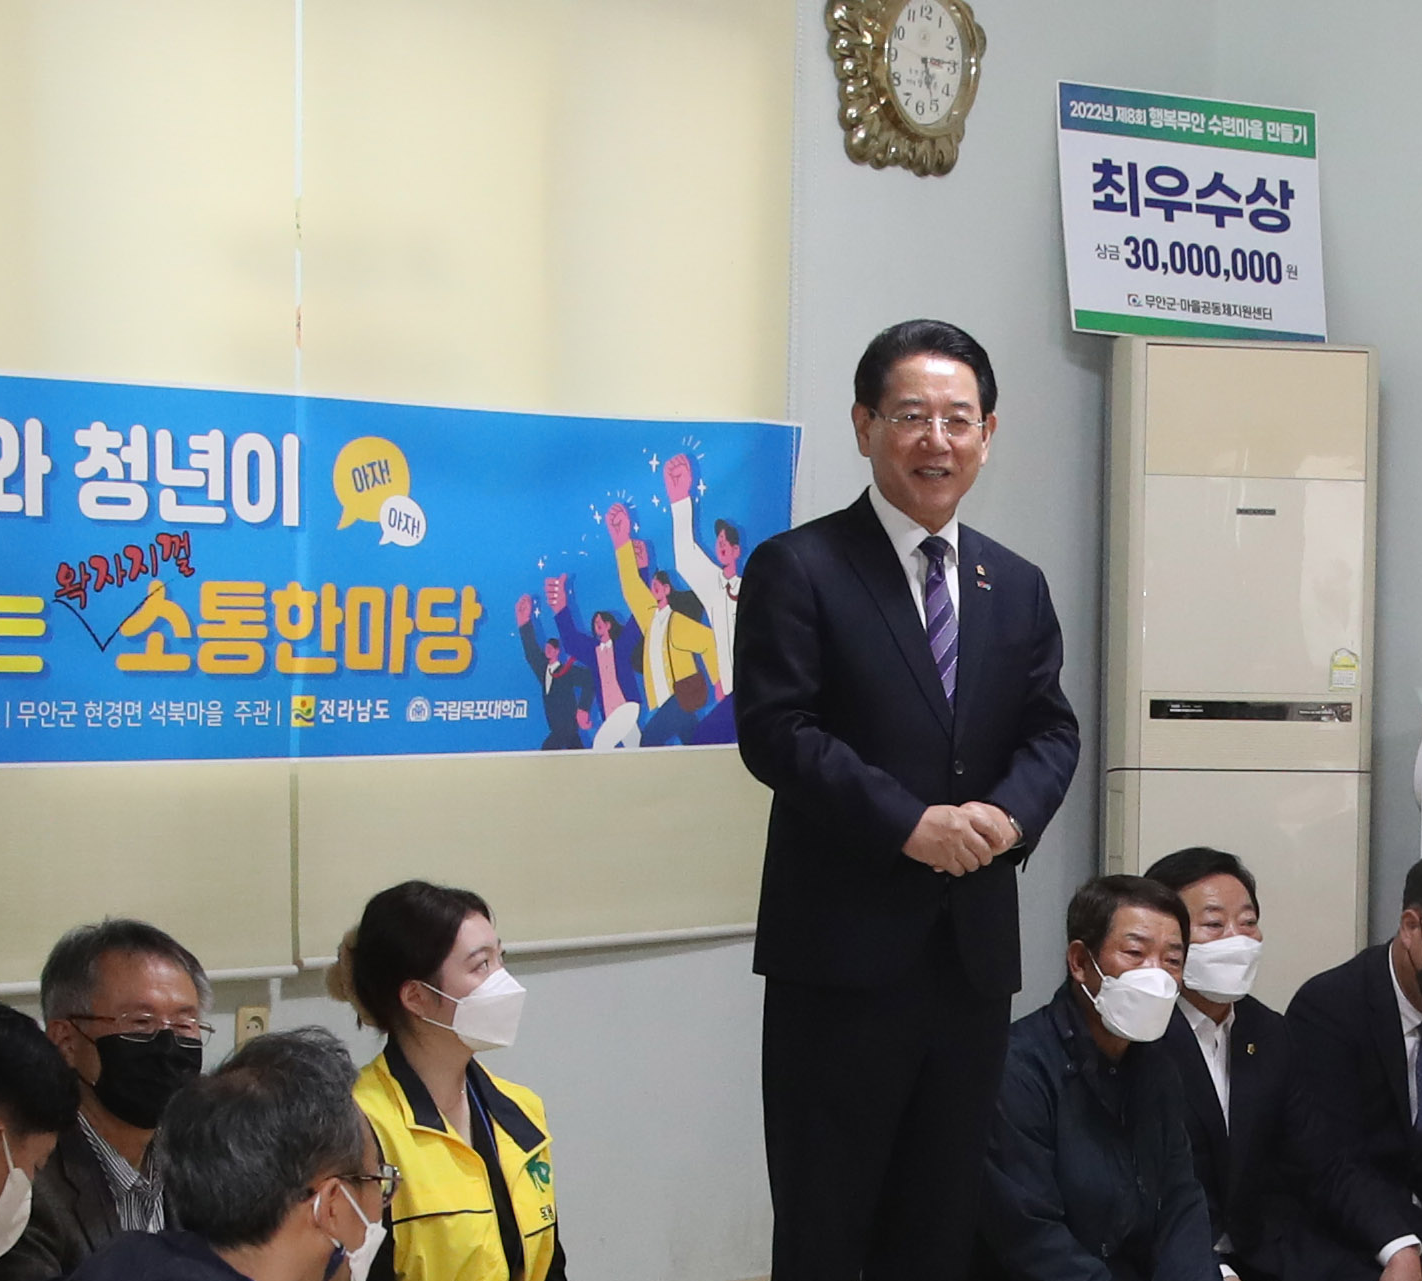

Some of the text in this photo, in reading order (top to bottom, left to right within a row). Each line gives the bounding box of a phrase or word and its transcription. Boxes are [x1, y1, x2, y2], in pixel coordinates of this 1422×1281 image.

[920, 5, 933, 21] 12
[889, 47, 898, 62] 9
[945, 35, 955, 51] 2
[892, 71, 901, 87] 8
[941, 82, 951, 98] 4
[903, 92, 912, 106] 7
[915, 99, 925, 116] 6
[929, 99, 939, 113] 5
[1069, 100, 1114, 123] 2022년
[1115, 106, 1147, 126] 제8회
[1148, 107, 1206, 133] 행복무안
[1092, 158, 1295, 234] 최우수상
[1094, 236, 1299, 285] 상금 30,000,000 원
[74, 421, 300, 527] 청년이
[351, 458, 393, 494] 아자!
[388, 506, 421, 539] 아자!
[55, 530, 196, 609] 왁자지껄
[116, 580, 482, 675] 소통한마당
[17, 701, 78, 728] 무안군
[84, 700, 143, 728] 현경면
[149, 700, 224, 727] 석북마을
[233, 700, 271, 727] 주관
[318, 699, 391, 724] 전라남도
[433, 699, 529, 722] 국립목포대학교
